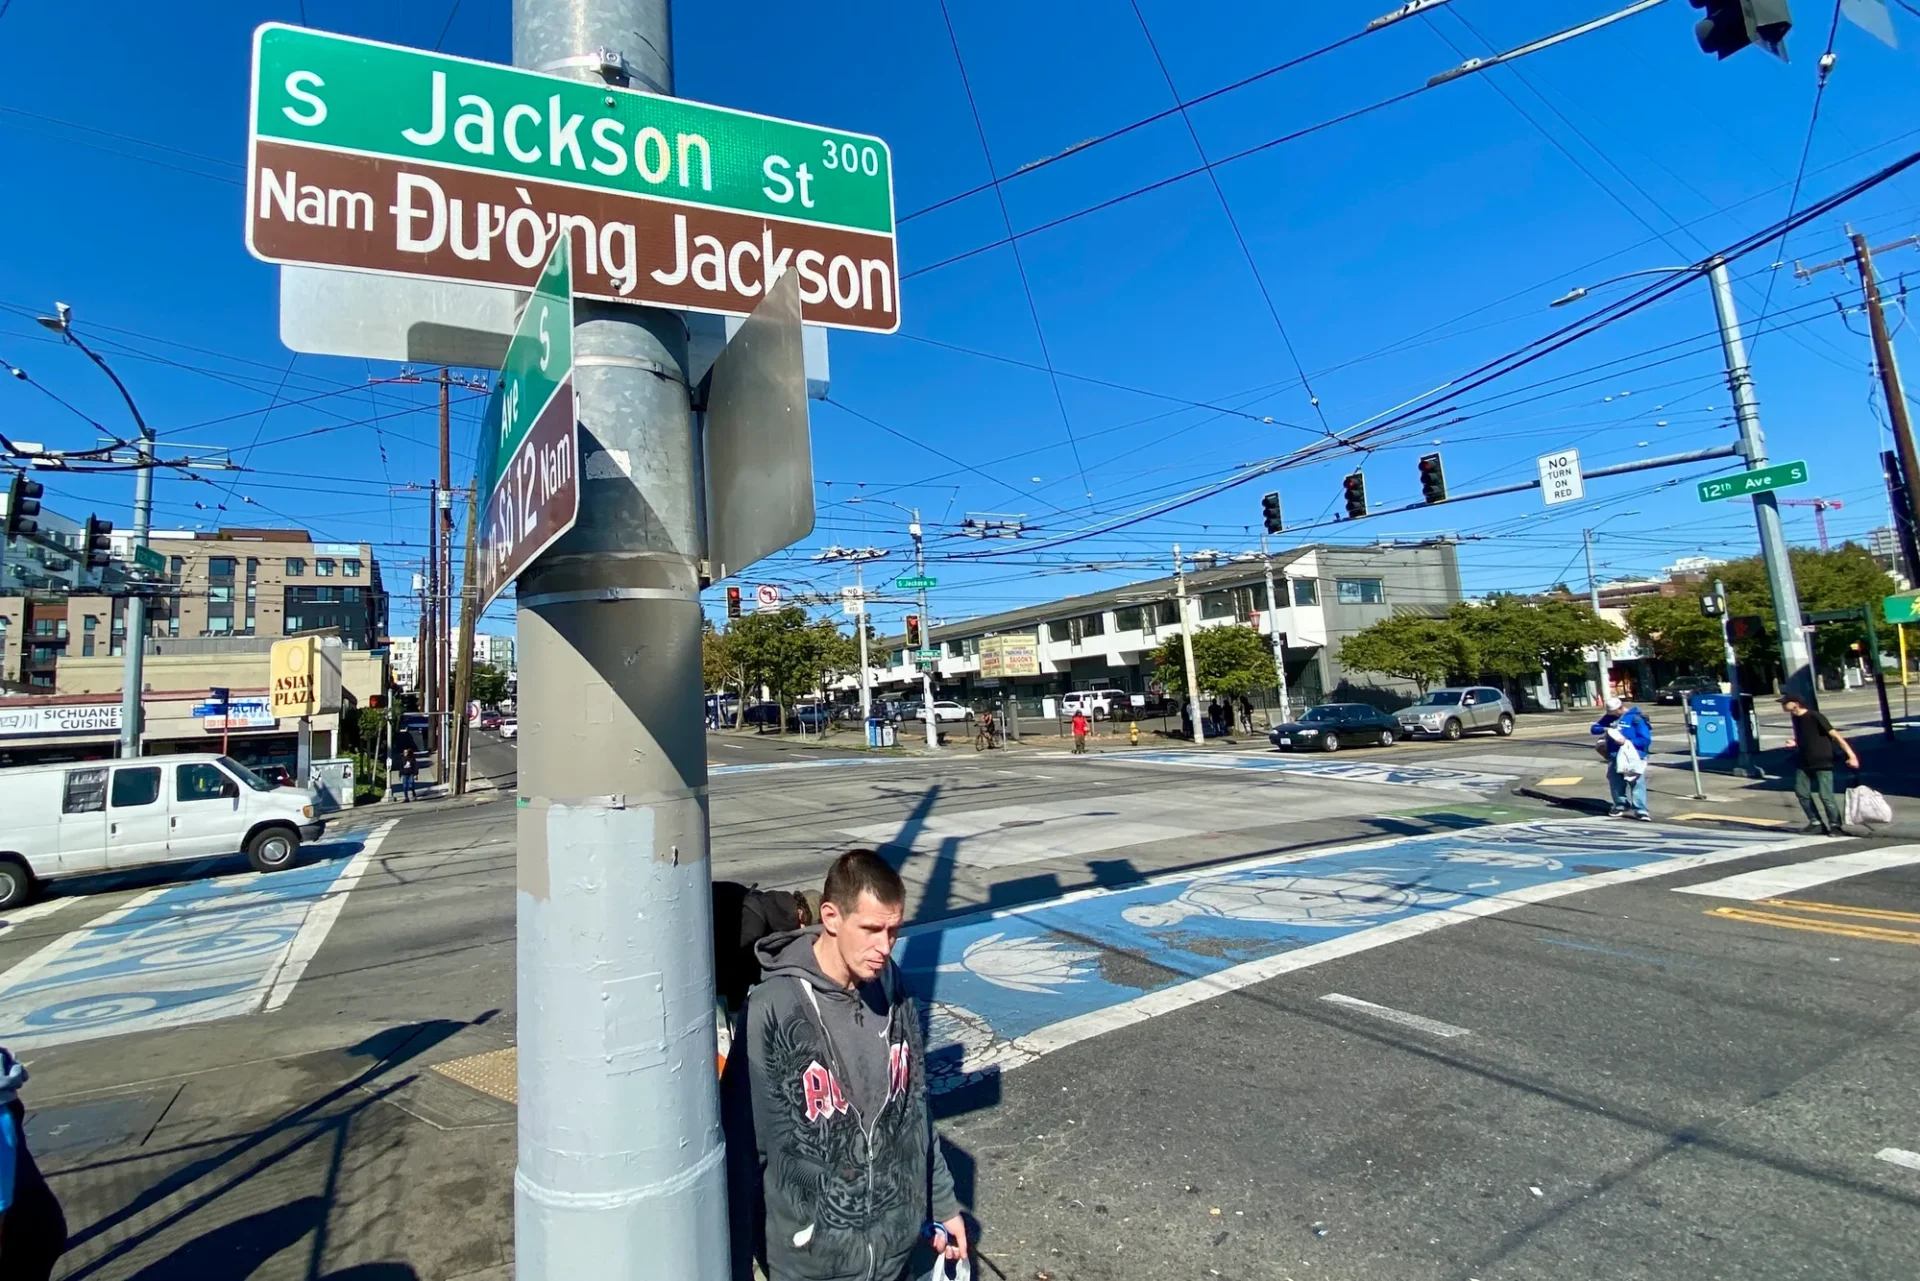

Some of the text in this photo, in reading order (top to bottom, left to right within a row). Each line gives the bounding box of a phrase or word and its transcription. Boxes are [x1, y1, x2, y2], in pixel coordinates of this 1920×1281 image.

[282, 70, 879, 209] S Jackson St 300
[259, 167, 893, 313] Nam Đường Jackson
[501, 305, 550, 448] Ave S
[1549, 457, 1568, 469] NO
[1548, 468, 1572, 480] TURN
[517, 441, 538, 543] 12
[540, 433, 571, 506] Nam
[1555, 480, 1568, 488] ON
[1702, 468, 1802, 499] 12th Ave S
[1554, 489, 1572, 498] RED
[275, 674, 315, 691] ASIAN
[274, 690, 316, 707] PLAZA
[60, 718, 117, 729] CUISINE
